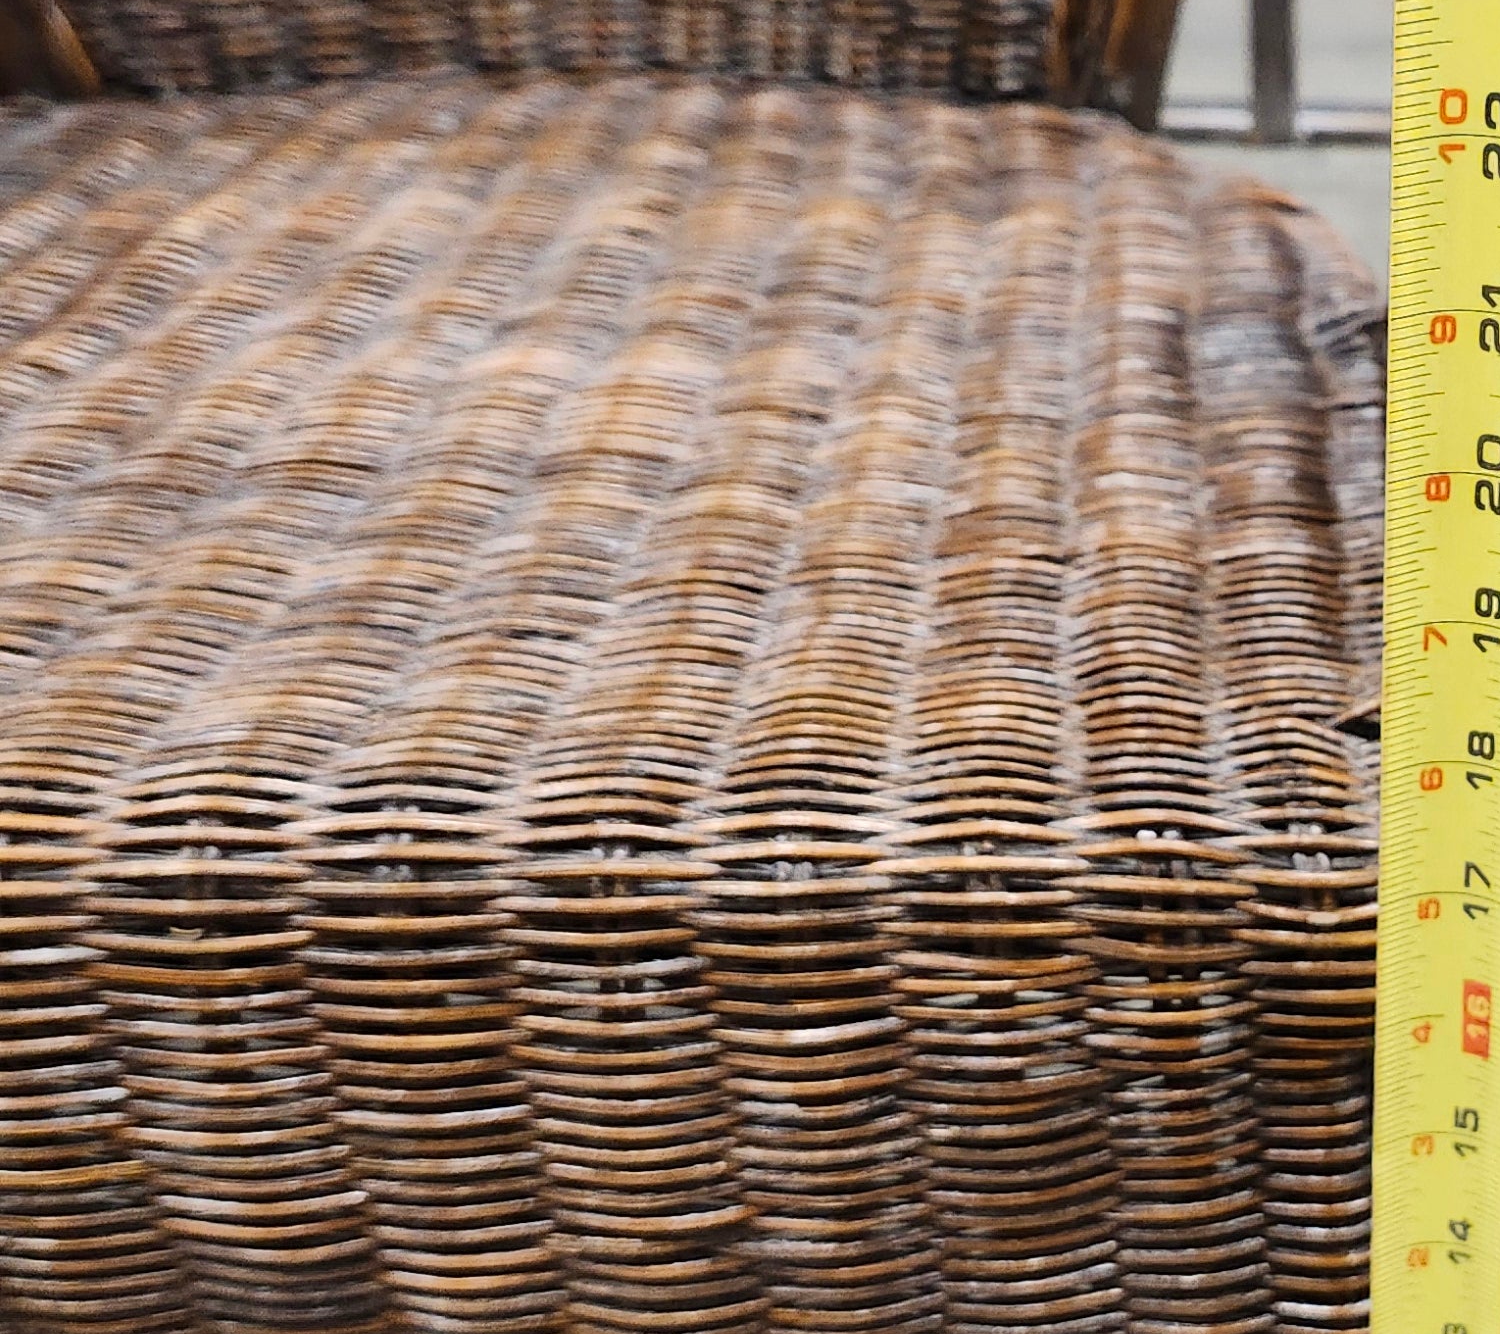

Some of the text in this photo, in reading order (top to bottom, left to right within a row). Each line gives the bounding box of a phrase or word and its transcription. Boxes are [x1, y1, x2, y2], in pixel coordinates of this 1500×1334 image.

[1438, 87, 1468, 165] 10
[1429, 314, 1457, 345] 9
[1425, 474, 1451, 502] 8
[1422, 626, 1448, 652] 7
[1465, 729, 1496, 790] 18
[1419, 766, 1443, 792] 6
[1462, 860, 1491, 920] 17
[1417, 897, 1441, 921] 5
[1465, 993, 1491, 1041] 16
[1411, 1020, 1434, 1044] 4
[1410, 1133, 1435, 1157] 3
[1453, 1105, 1480, 1158] 15
[1447, 1218, 1473, 1265] 14
[1406, 1246, 1430, 1269] 2
